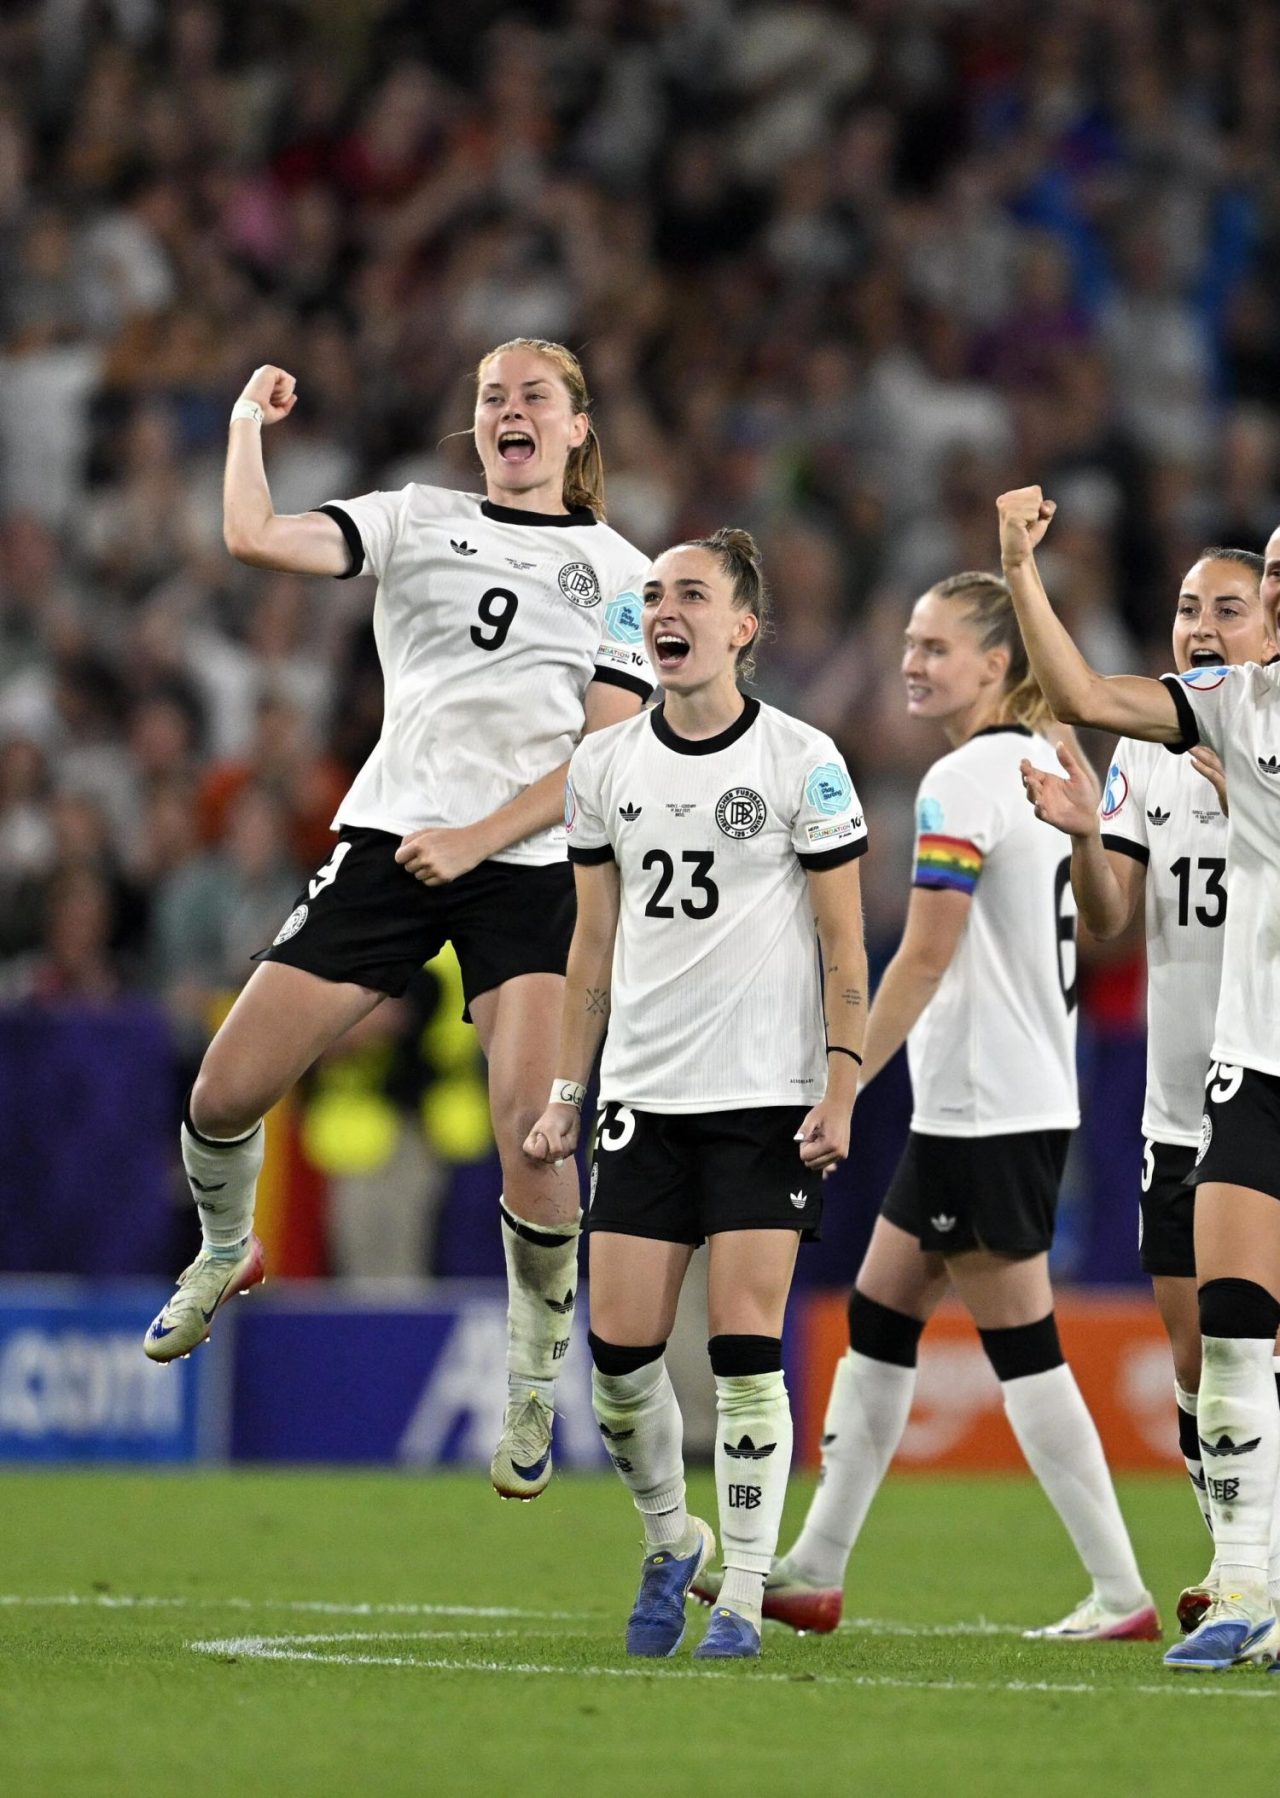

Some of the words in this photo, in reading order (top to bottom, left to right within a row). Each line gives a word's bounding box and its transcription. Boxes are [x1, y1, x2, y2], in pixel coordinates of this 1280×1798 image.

[470, 588, 518, 651] 9
[643, 849, 718, 919] 23
[1170, 856, 1228, 928] 13
